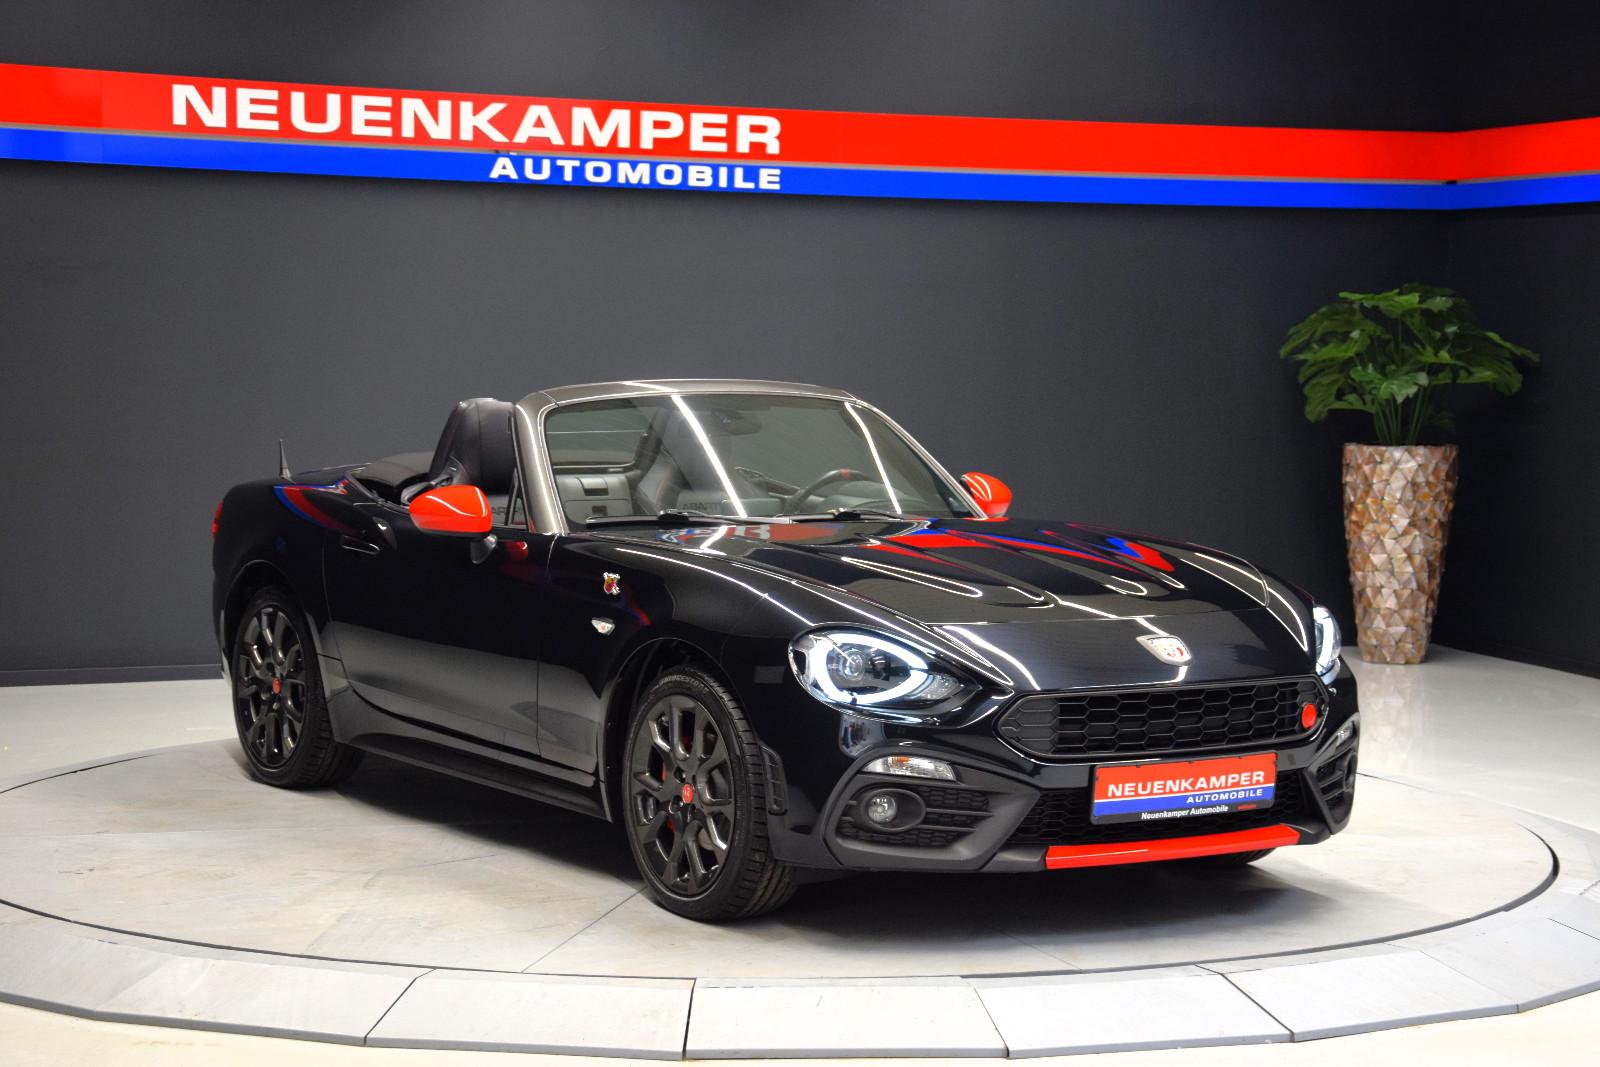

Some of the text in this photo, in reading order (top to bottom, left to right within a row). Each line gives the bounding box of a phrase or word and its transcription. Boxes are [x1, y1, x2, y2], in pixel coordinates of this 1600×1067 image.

[171, 83, 782, 155] NEUENKAMPER
[489, 156, 782, 191] AUTOMOBILE
[1107, 770, 1266, 798] NEUENKAMPER
[1186, 788, 1264, 804] AUTOMOBILE
[1140, 807, 1189, 820] Neuenkamper
[1189, 804, 1229, 815] Automobile
